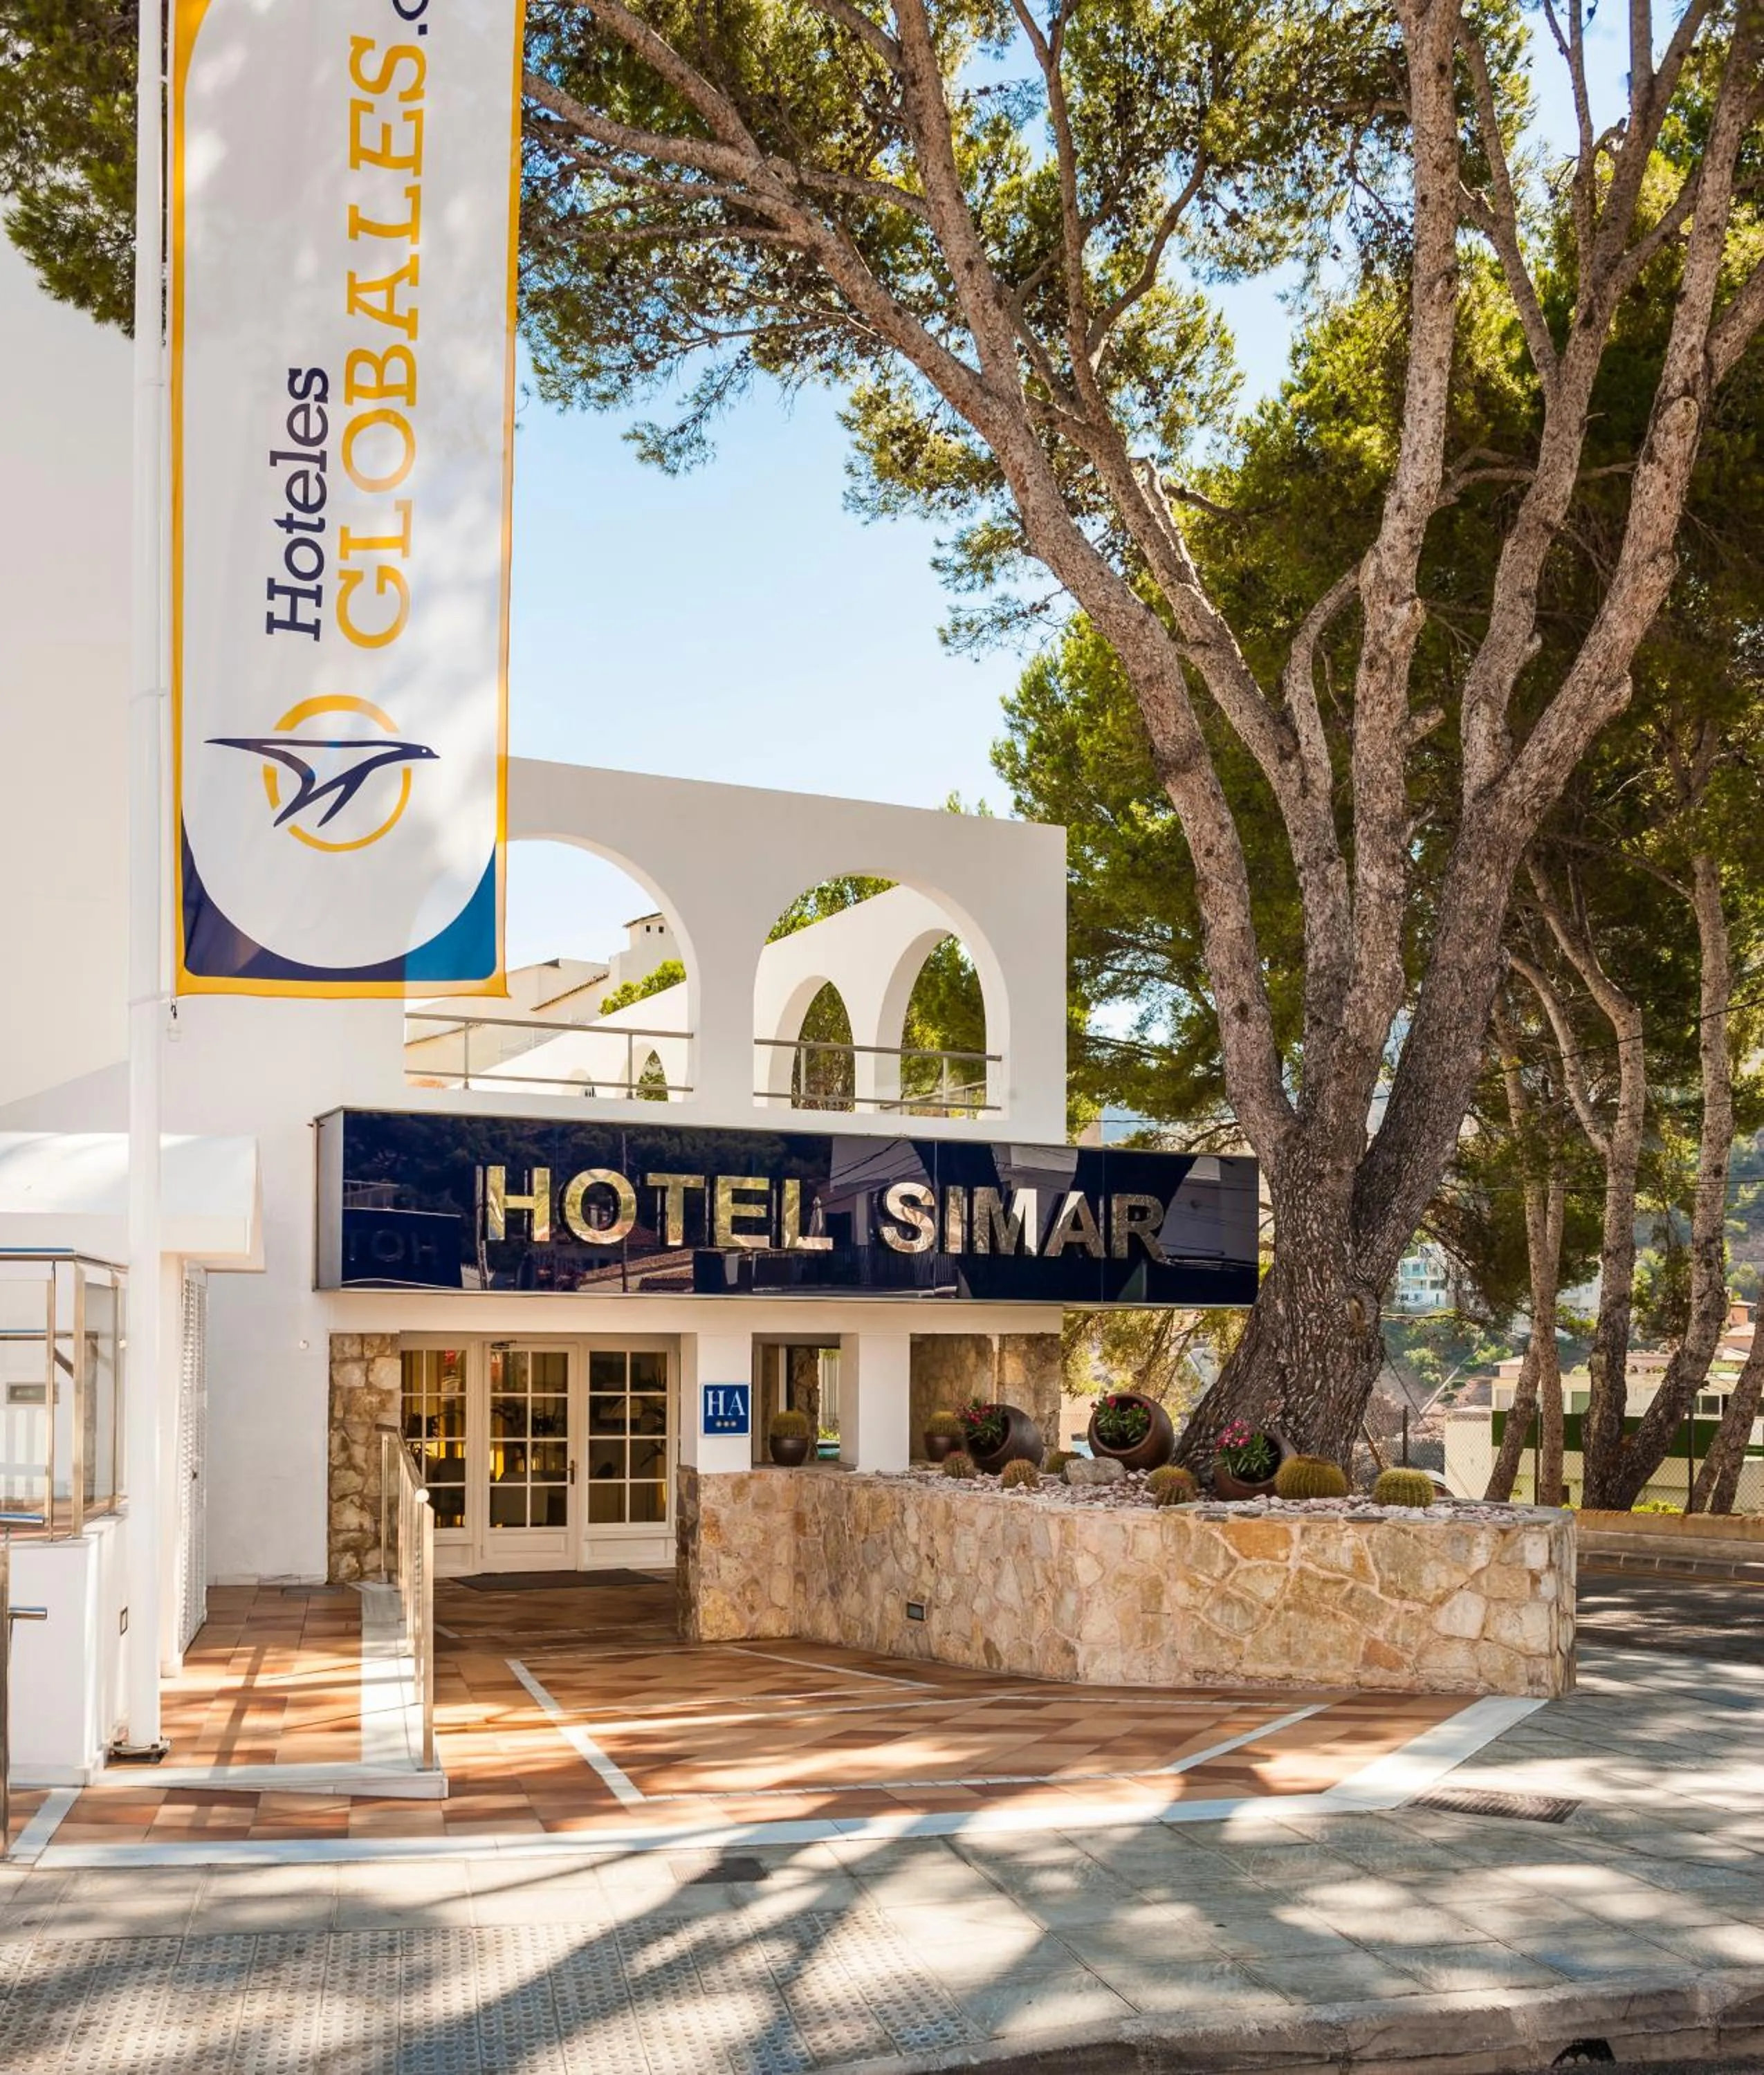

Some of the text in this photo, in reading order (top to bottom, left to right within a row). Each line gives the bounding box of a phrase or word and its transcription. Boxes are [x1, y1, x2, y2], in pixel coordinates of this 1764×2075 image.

[266, 368, 329, 642] Hoteles
[486, 1165, 1169, 1263] HOTEL SIMAR
[706, 1390, 746, 1416] HA
